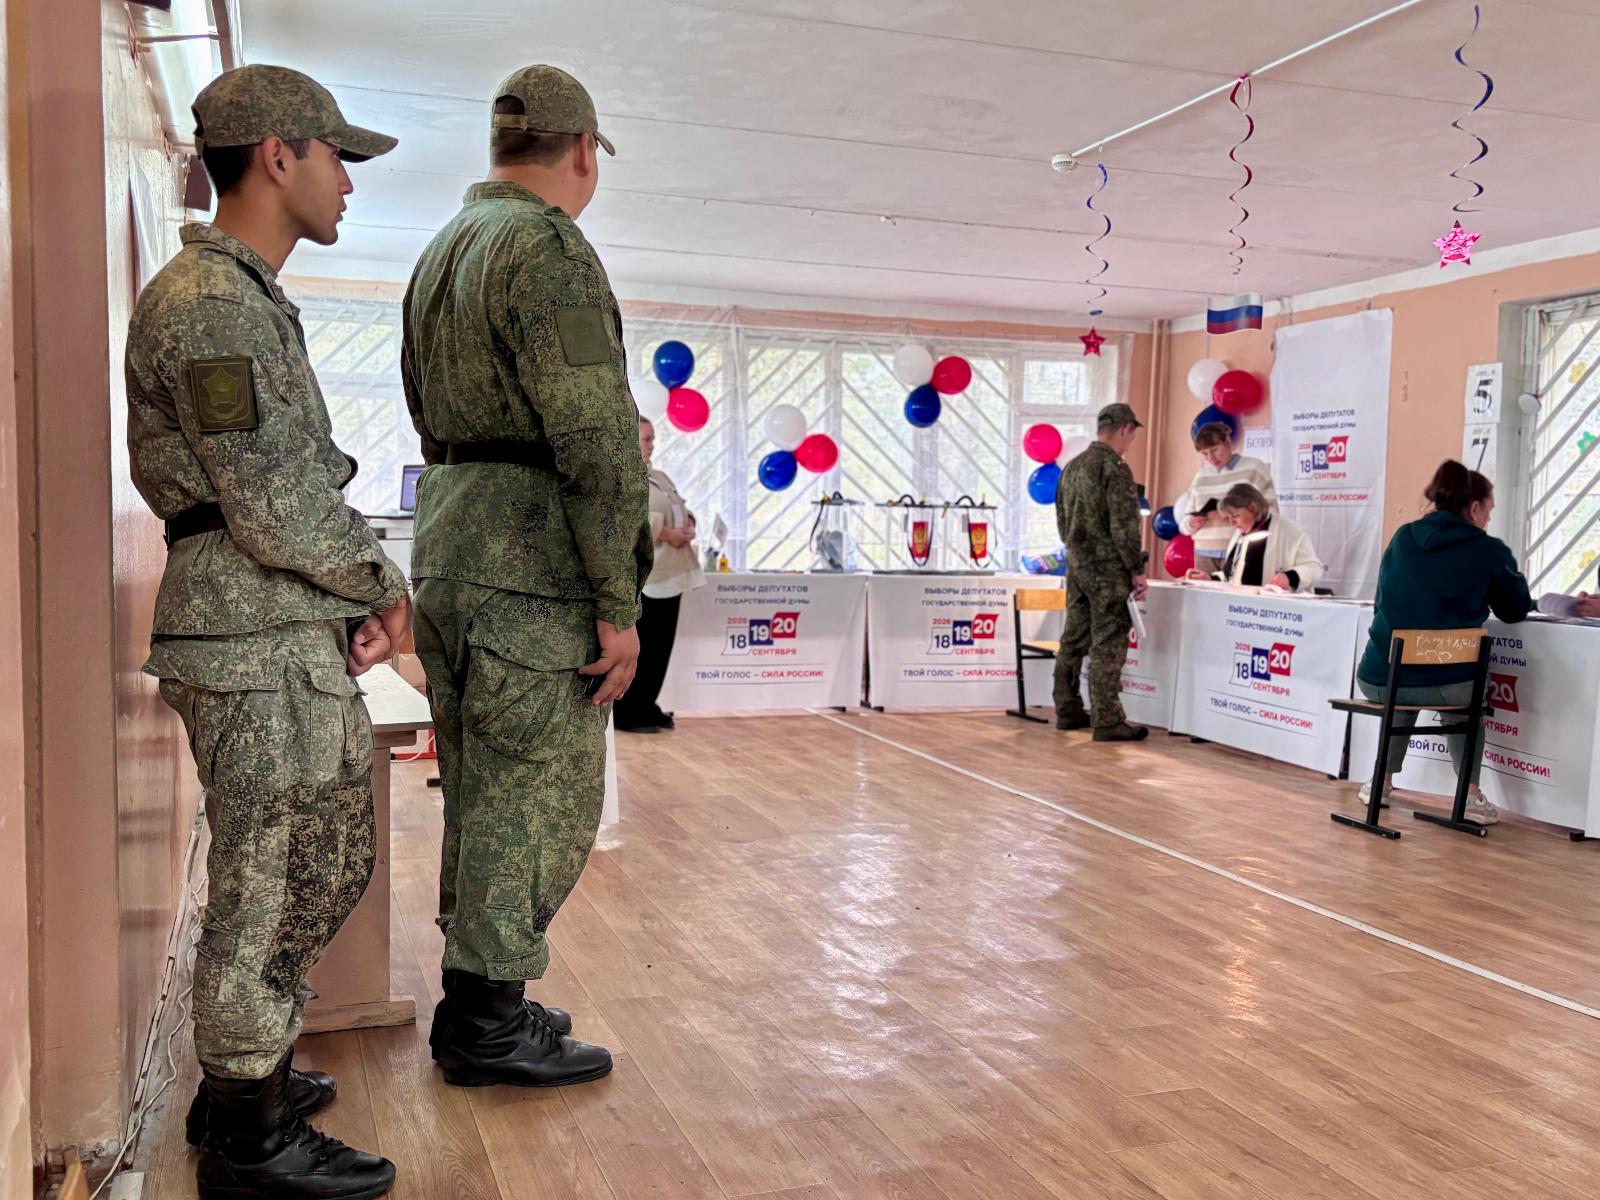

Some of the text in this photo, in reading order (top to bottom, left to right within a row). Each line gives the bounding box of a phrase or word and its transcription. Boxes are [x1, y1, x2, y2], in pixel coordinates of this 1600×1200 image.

[1473, 378, 1493, 414] 5
[1300, 441, 1345, 473] 18 19 20
[1471, 437, 1489, 471] 7
[714, 597, 787, 605] ГОСУДАРСТВЕННОЙ
[922, 599, 987, 607] ГОСУДАРСТВЕННОЙ
[1228, 605, 1303, 622] ВЫБОРЫ ДЕПУТАТОВ
[729, 617, 795, 649] 18 19 20
[934, 619, 994, 649] 18 19 20
[1226, 618, 1304, 637] ГОСУДАРСТВЕННОЙ ДУМЫ
[1490, 636, 1523, 649] ТАТОВ
[752, 648, 797, 656] СЕНТЯБРЯ
[1236, 649, 1290, 680] 18 19 20
[1500, 656, 1526, 667] ДУМЫ
[696, 671, 720, 679] ТВОЙ
[722, 671, 751, 679] ГОЛОС
[904, 669, 925, 677] ТВОЙ
[1253, 682, 1290, 696] СЕНТЯБРЯ
[1490, 681, 1514, 703] 20
[1210, 697, 1228, 709] ТВОЙ
[1229, 703, 1251, 714] ГОЛОС
[1259, 709, 1278, 721] СИЛА
[1280, 714, 1313, 729] РОССИИ!
[1484, 719, 1518, 736] НТЯБРЯ
[1409, 739, 1429, 751] ВОЙ
[1484, 750, 1505, 765] СИЛА
[1507, 757, 1550, 778] РОССИИ!
